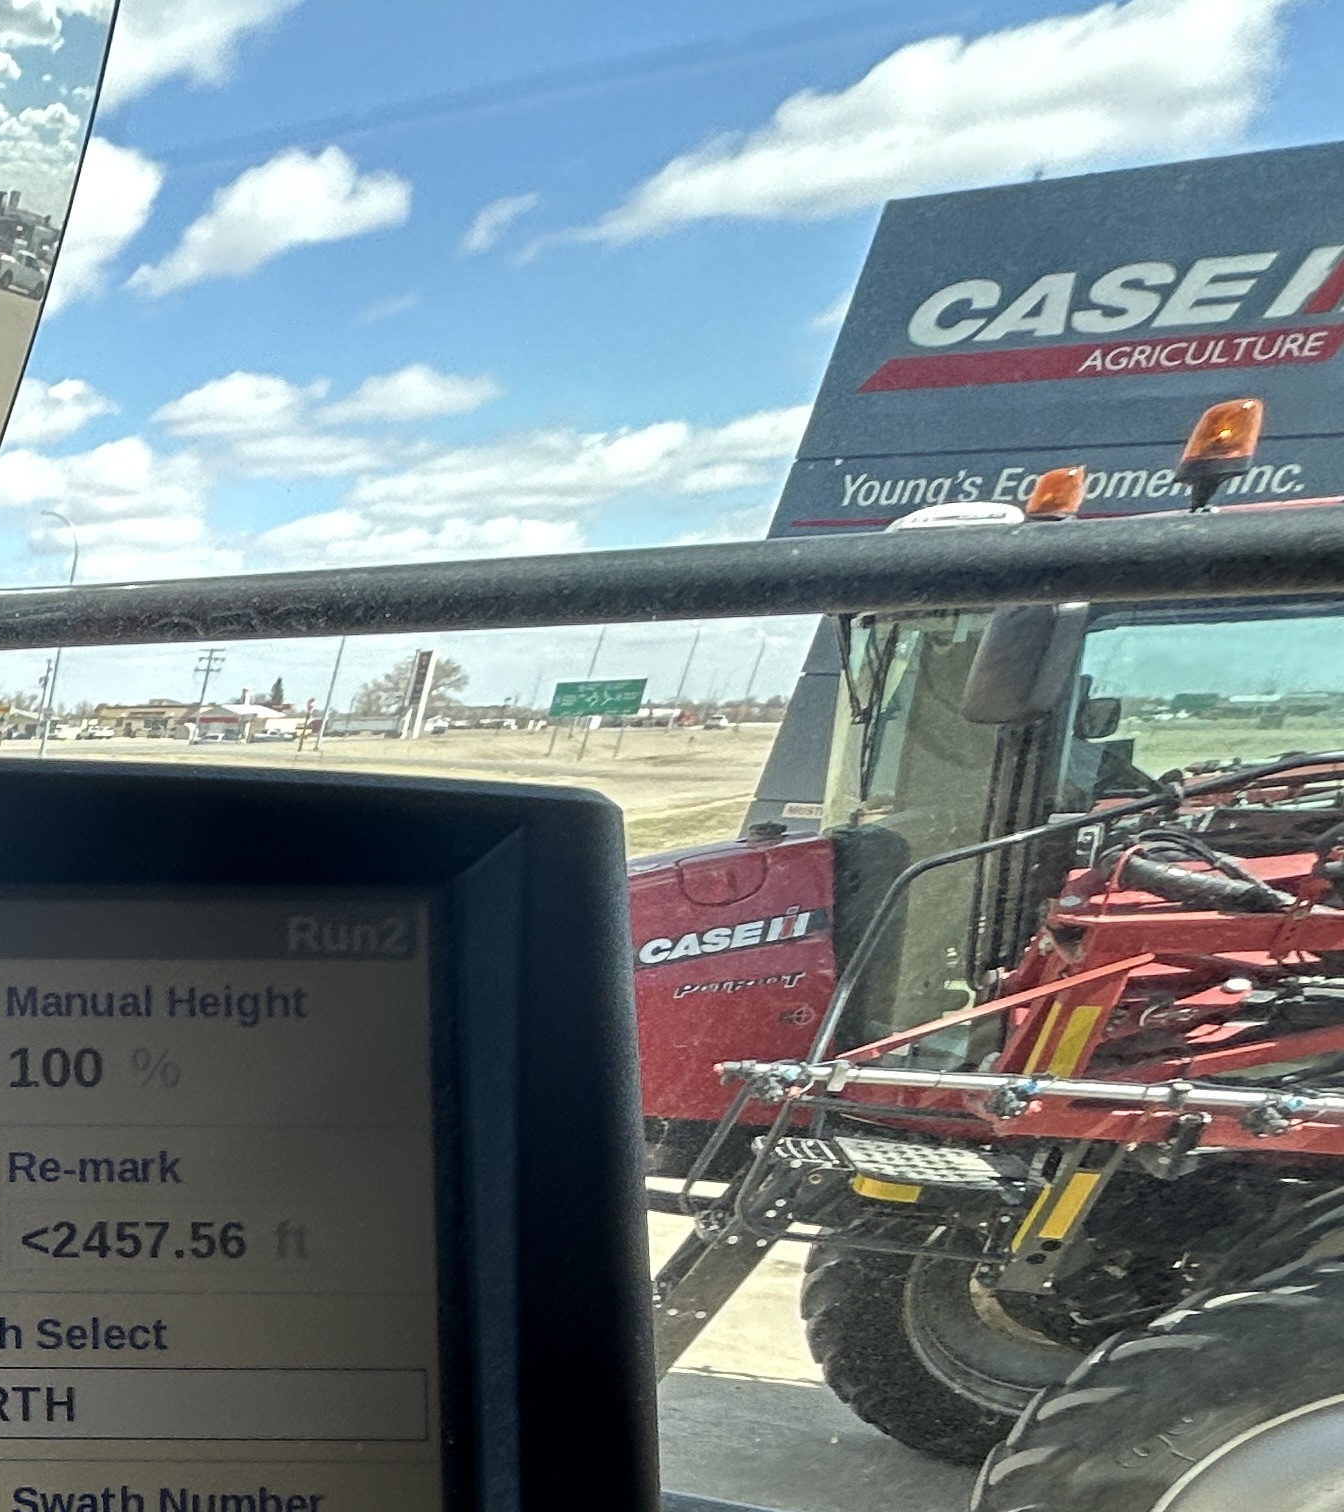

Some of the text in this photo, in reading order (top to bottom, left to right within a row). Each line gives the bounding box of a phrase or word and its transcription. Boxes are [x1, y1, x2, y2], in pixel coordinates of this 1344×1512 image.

[907, 249, 1279, 350] CASE
[1079, 331, 1327, 374] AGRICULTURE
[840, 468, 984, 508] Young's
[287, 916, 409, 952] Run2
[639, 920, 764, 964] CASE
[6, 985, 307, 1026] Manual Height
[9, 1047, 181, 1089] 100 %
[9, 1151, 182, 1183] Re-mark
[22, 1219, 310, 1259] <2457.56 ft
[36, 1318, 168, 1350] Select
